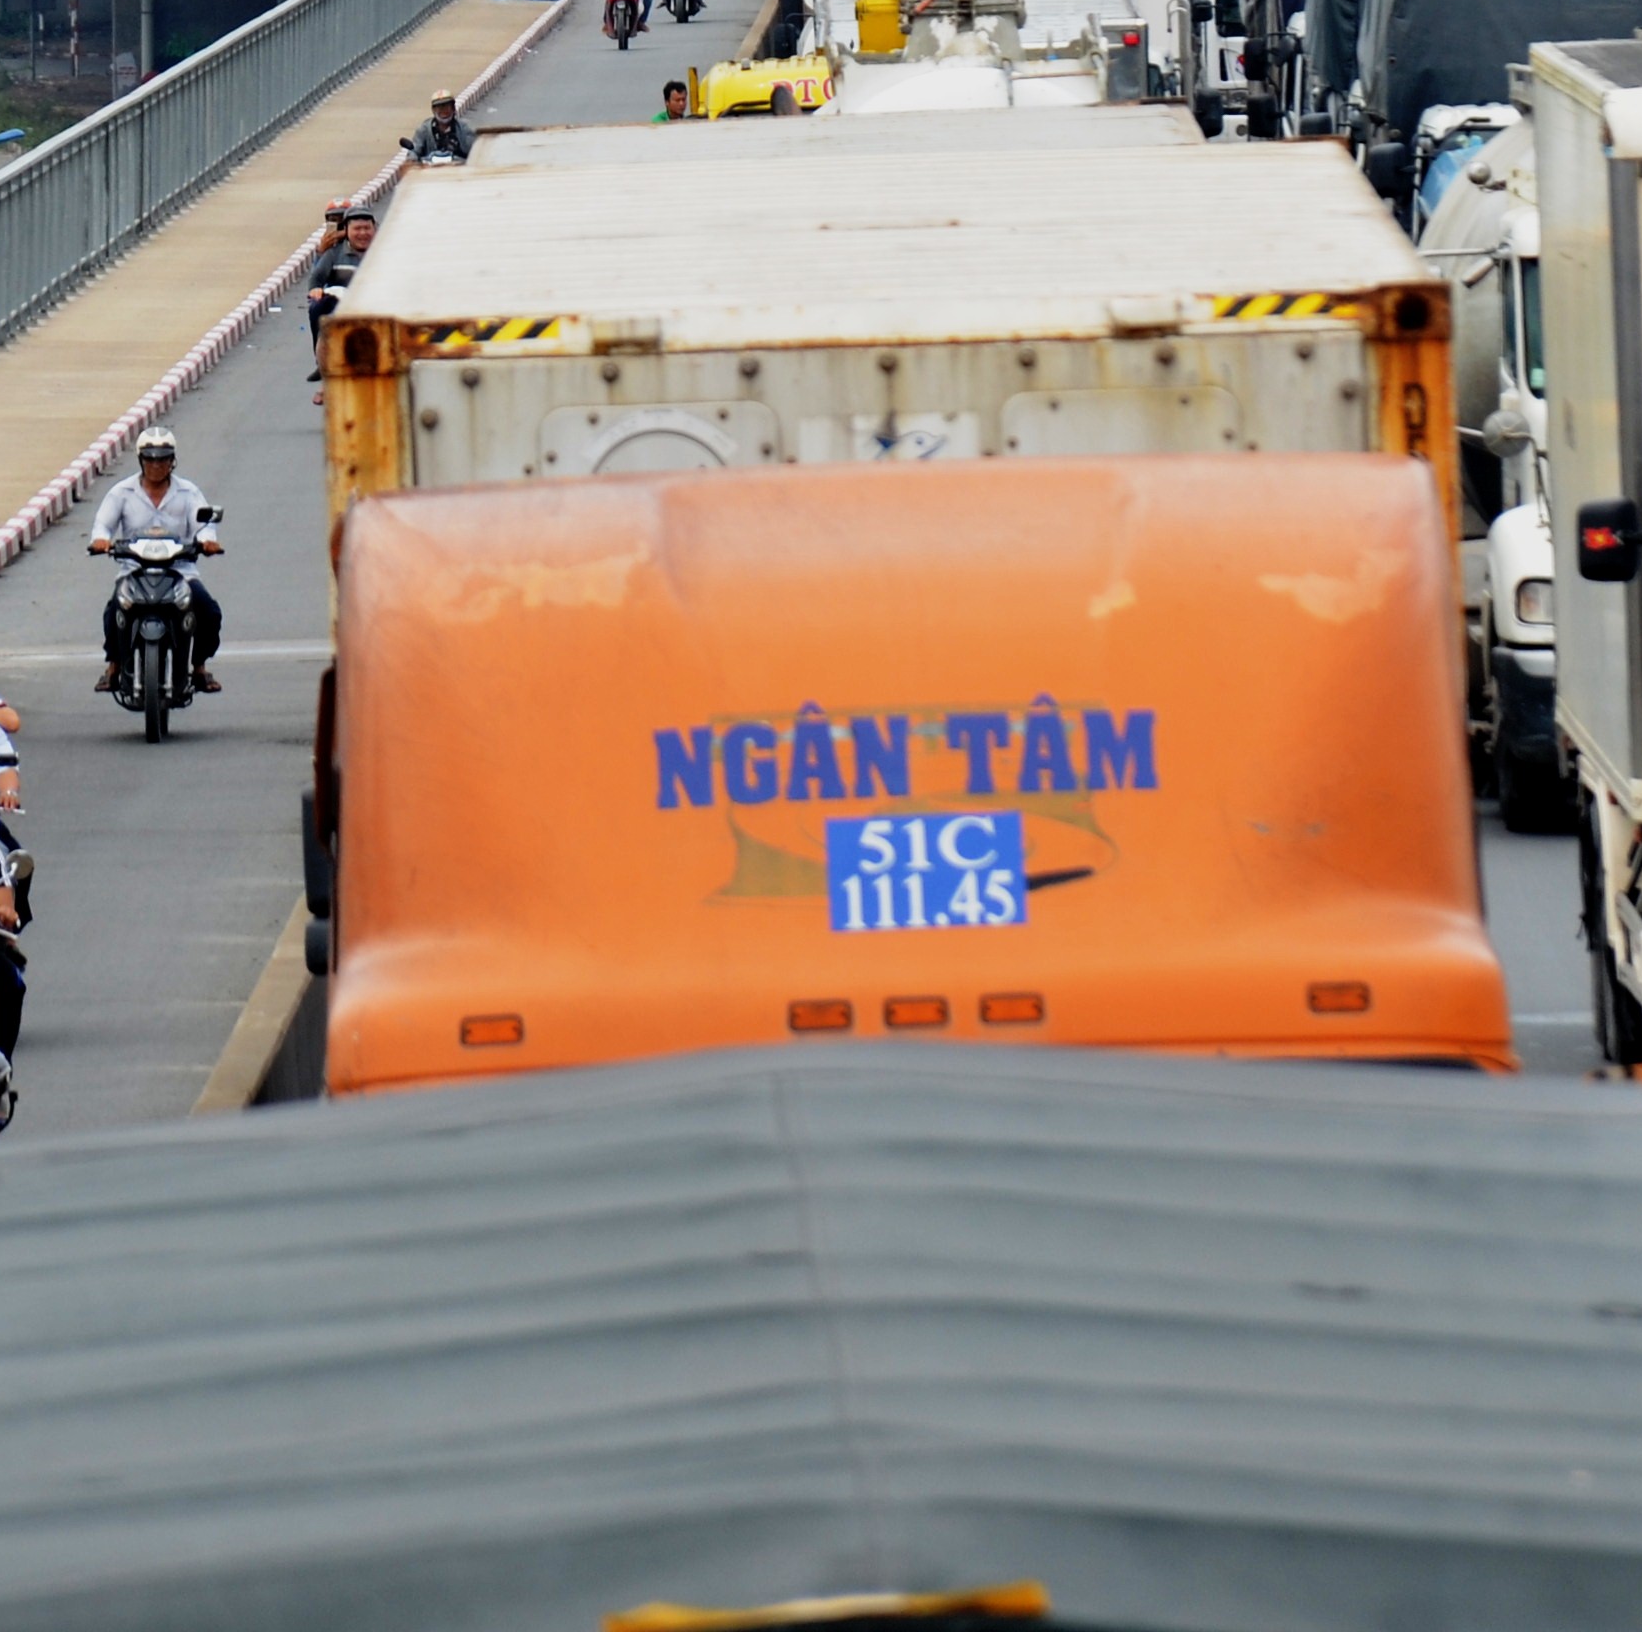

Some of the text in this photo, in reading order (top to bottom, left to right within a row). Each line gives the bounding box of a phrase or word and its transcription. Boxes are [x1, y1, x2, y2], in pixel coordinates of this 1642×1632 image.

[653, 692, 1159, 810] NGÂN TÂM
[856, 814, 999, 872] 51C
[839, 867, 1018, 932] 111.45
